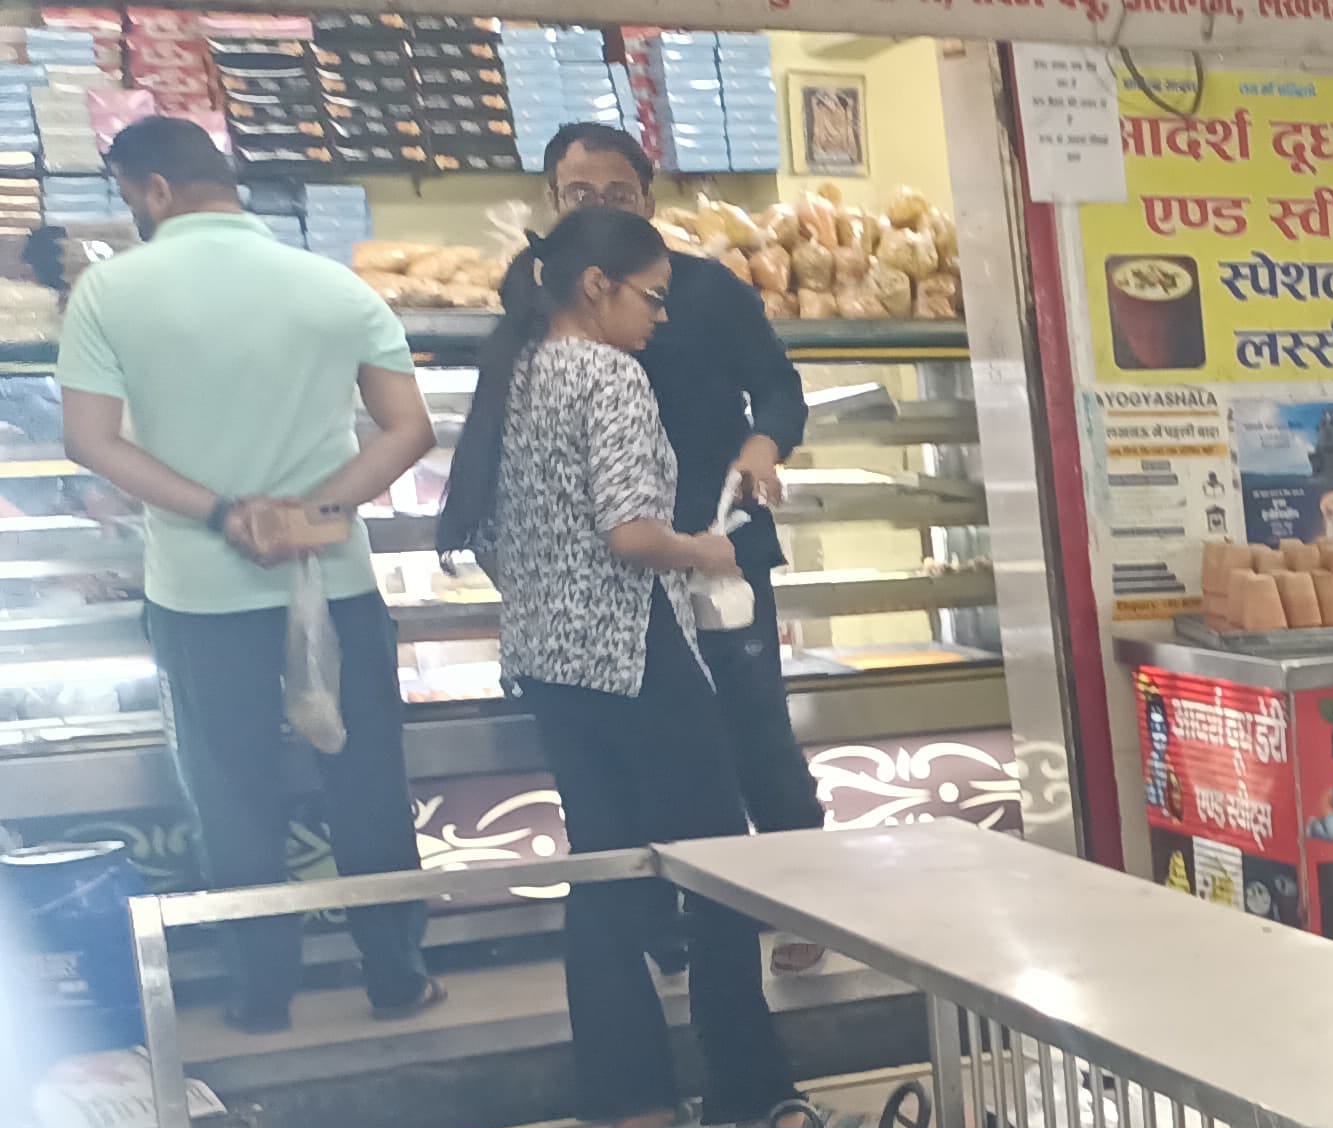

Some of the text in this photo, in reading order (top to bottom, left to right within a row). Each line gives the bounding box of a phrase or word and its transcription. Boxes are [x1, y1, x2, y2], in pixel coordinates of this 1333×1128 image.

[1140, 193, 1251, 239] एण्ड
[1103, 391, 1219, 408] YOGYASHALA
[1170, 686, 1288, 778] आदर्श दूध डेरी
